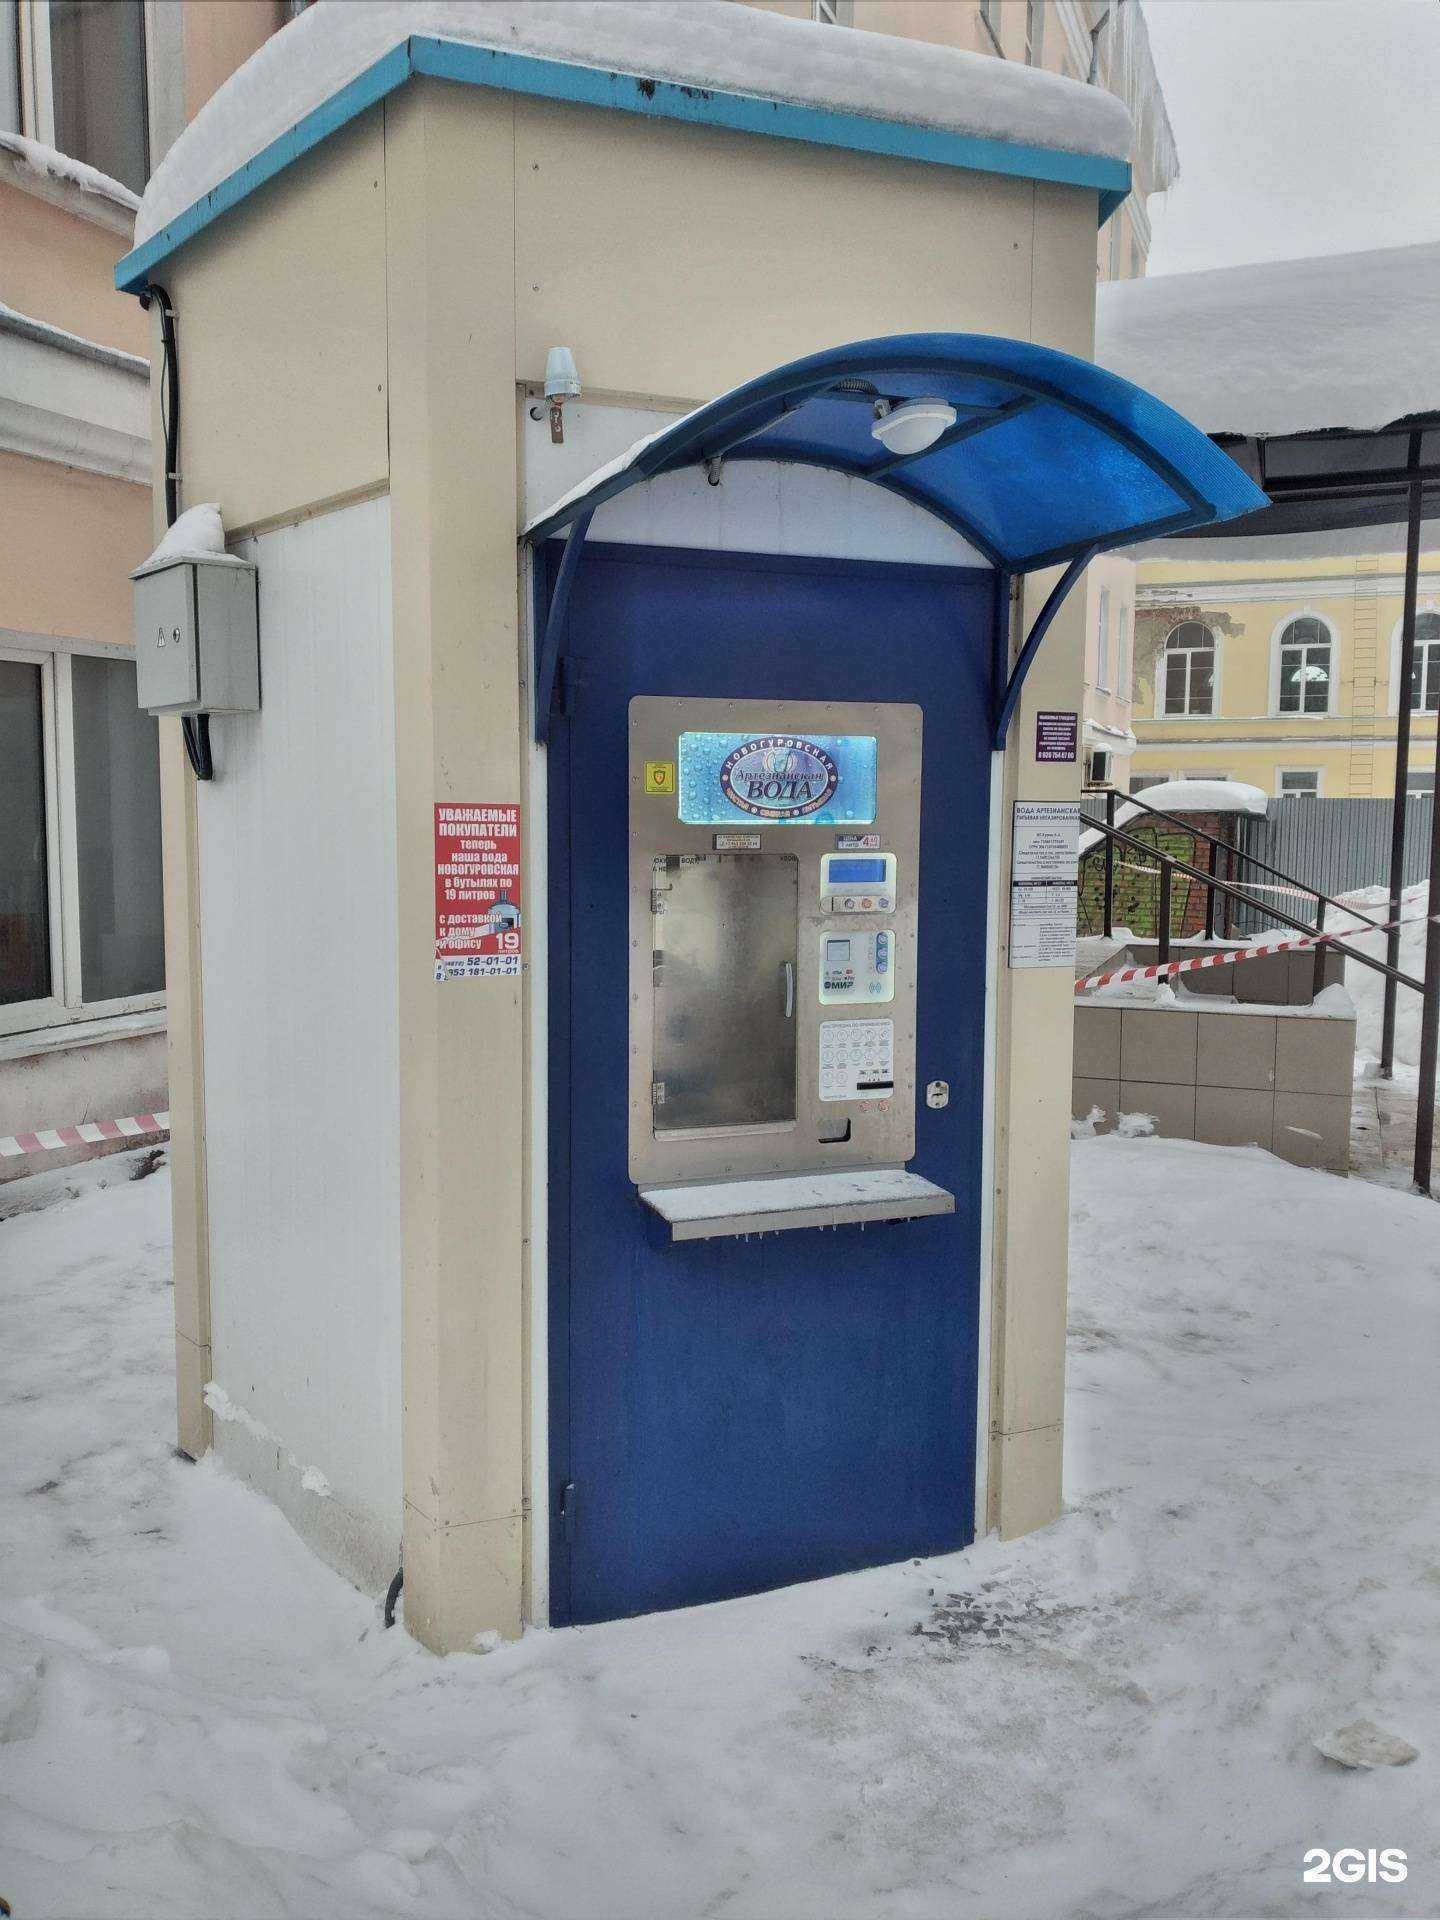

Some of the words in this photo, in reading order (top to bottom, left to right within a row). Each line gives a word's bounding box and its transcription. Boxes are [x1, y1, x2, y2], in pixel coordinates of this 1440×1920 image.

[725, 738, 834, 770] НОВОГУРОВСКАЯ
[746, 780, 814, 801] ВОДА
[438, 808, 517, 823] УВАЖАЕМЫЕ
[439, 823, 518, 838] ПОКУПАТЕЛИ
[460, 839, 497, 851] теперь
[451, 852, 481, 863] наша
[481, 851, 508, 863] вода
[437, 863, 519, 876] НОВОГУРОВСКАЯ
[444, 878, 452, 888] в
[453, 876, 498, 889] бутылях
[499, 878, 513, 888] по
[444, 889, 457, 901] 19
[458, 890, 496, 901] литров
[439, 915, 446, 924] с
[447, 913, 503, 925] доставкой
[439, 928, 446, 937] к
[448, 927, 475, 939] дому
[448, 939, 482, 951] офису
[495, 933, 520, 950] 19
[466, 956, 519, 966] 52-01-01
[467, 966, 519, 977] 181-01-01
[831, 981, 855, 990] МИР
